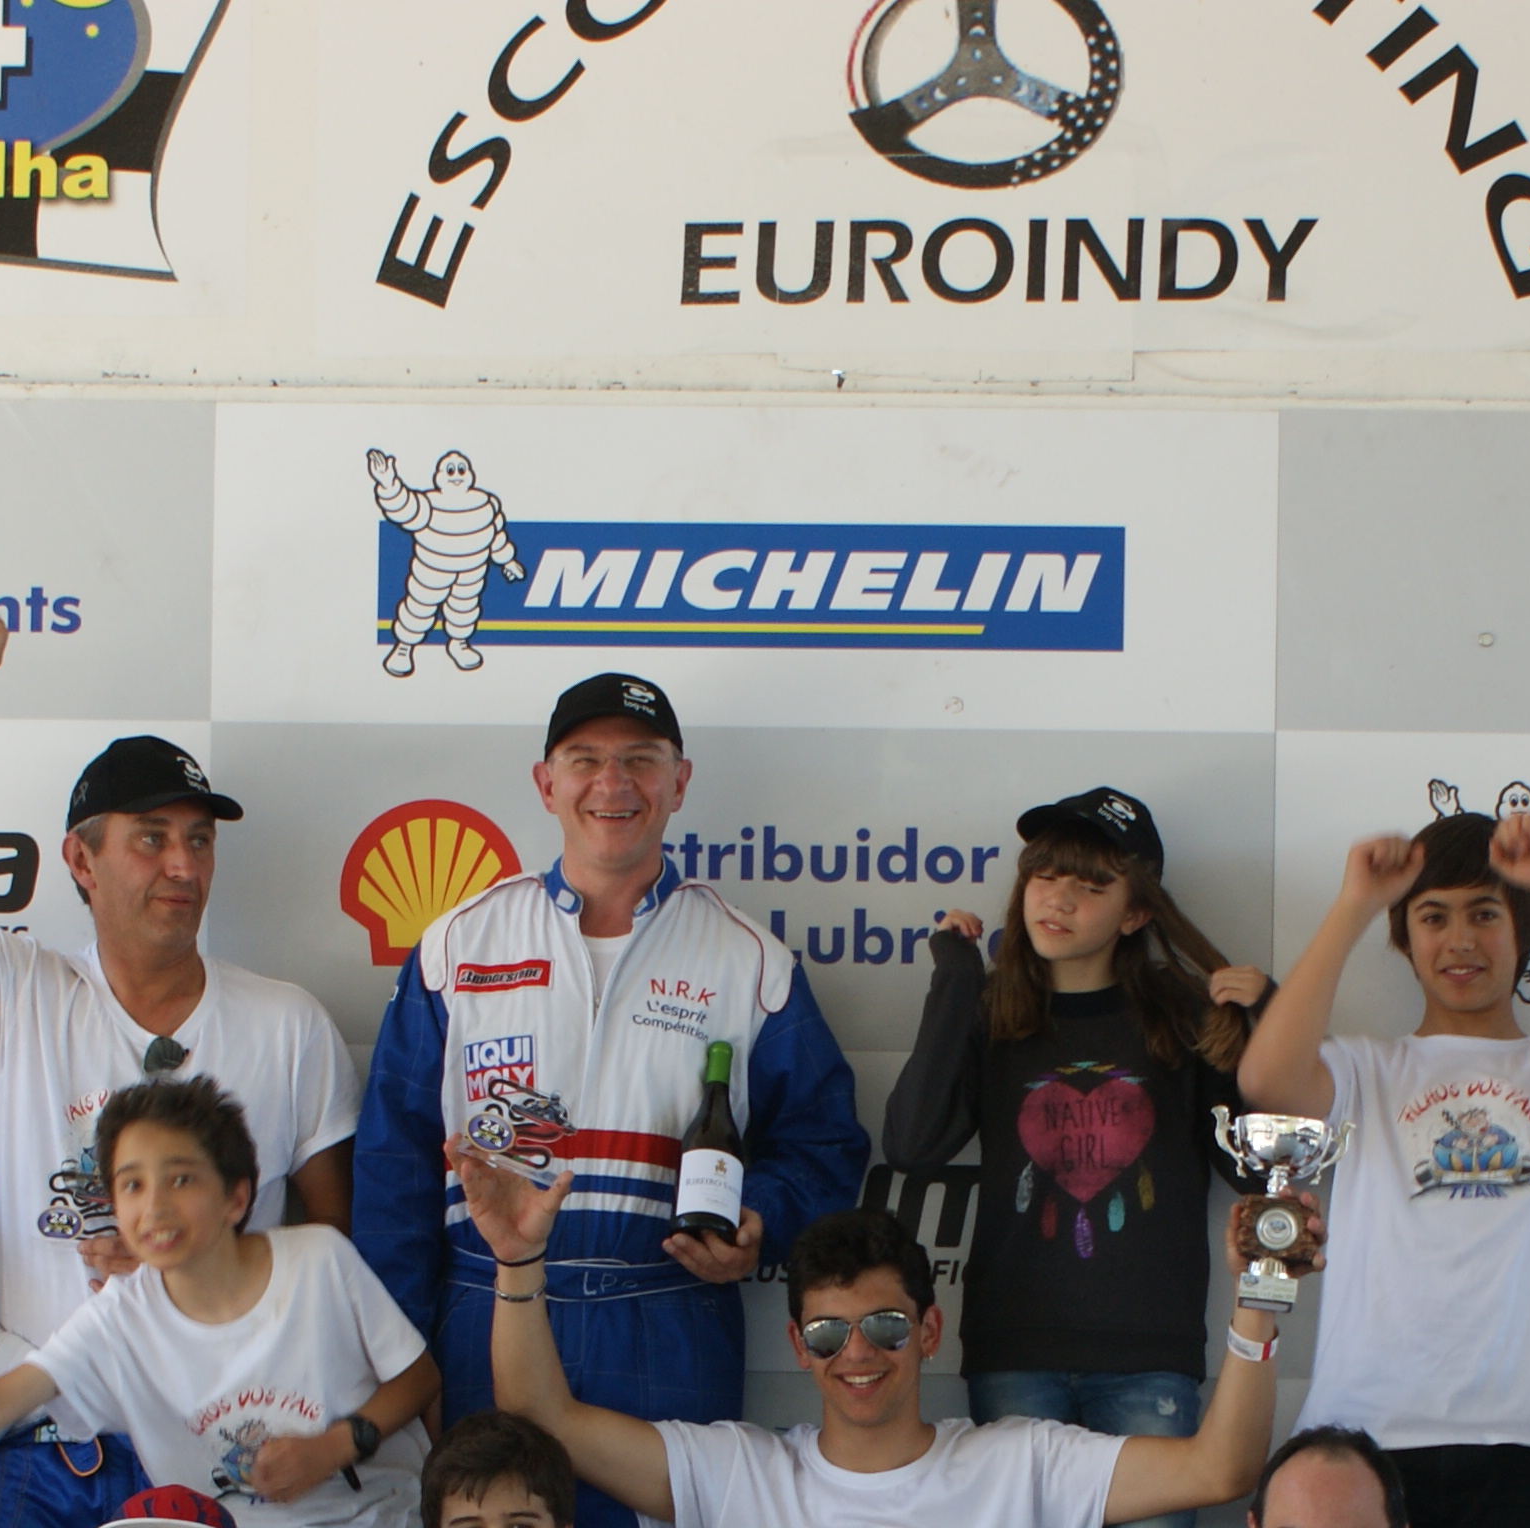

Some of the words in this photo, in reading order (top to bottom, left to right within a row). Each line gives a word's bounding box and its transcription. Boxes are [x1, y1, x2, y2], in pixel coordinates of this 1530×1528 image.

[679, 217, 1319, 306] EUROINDY
[523, 549, 1102, 614] MICHELIN
[662, 825, 1001, 884] tribuidor
[645, 999, 709, 1026] L'esprit
[464, 1034, 534, 1072] LIQUI
[467, 1064, 535, 1102] MOLY
[1043, 1096, 1120, 1131] NATIVE
[1059, 1133, 1114, 1172] GIRL
[1448, 1183, 1508, 1200] TEAM
